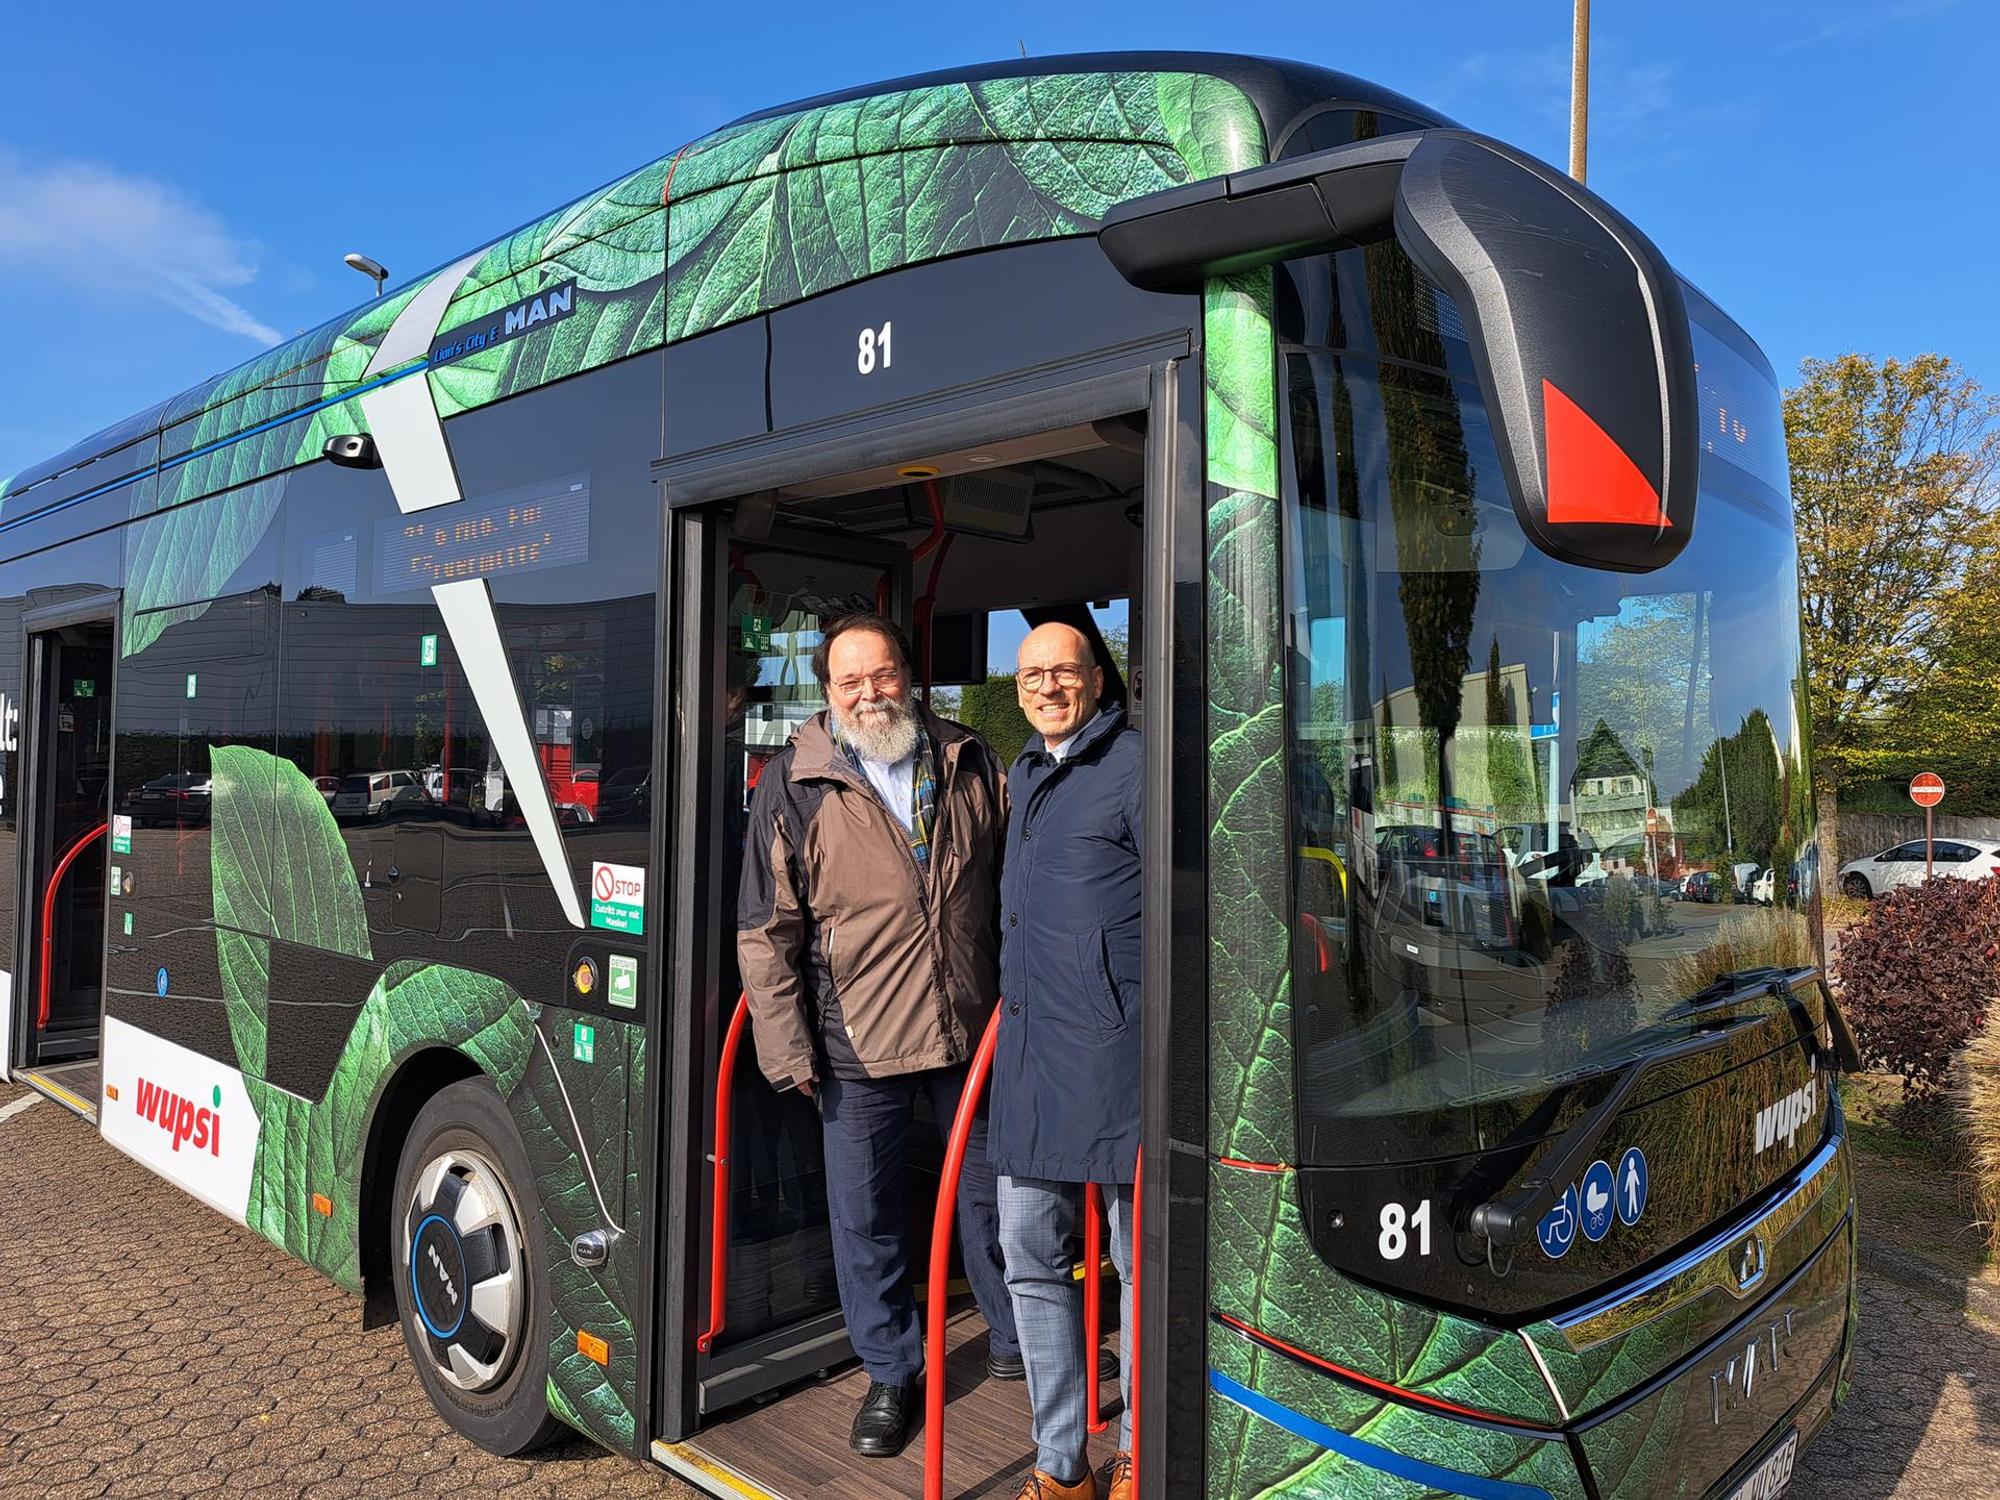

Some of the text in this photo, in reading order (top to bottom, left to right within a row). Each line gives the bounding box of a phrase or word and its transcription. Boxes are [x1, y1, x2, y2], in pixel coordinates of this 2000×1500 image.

[504, 285, 573, 337] MAN
[433, 327, 499, 364] Lion's City E
[858, 320, 892, 375] 81
[615, 879, 642, 897] STOP
[136, 1077, 221, 1158] wupsi
[1755, 1053, 1817, 1155] wupsi
[1378, 1199, 1430, 1260] 81
[428, 1242, 459, 1306] MAN
